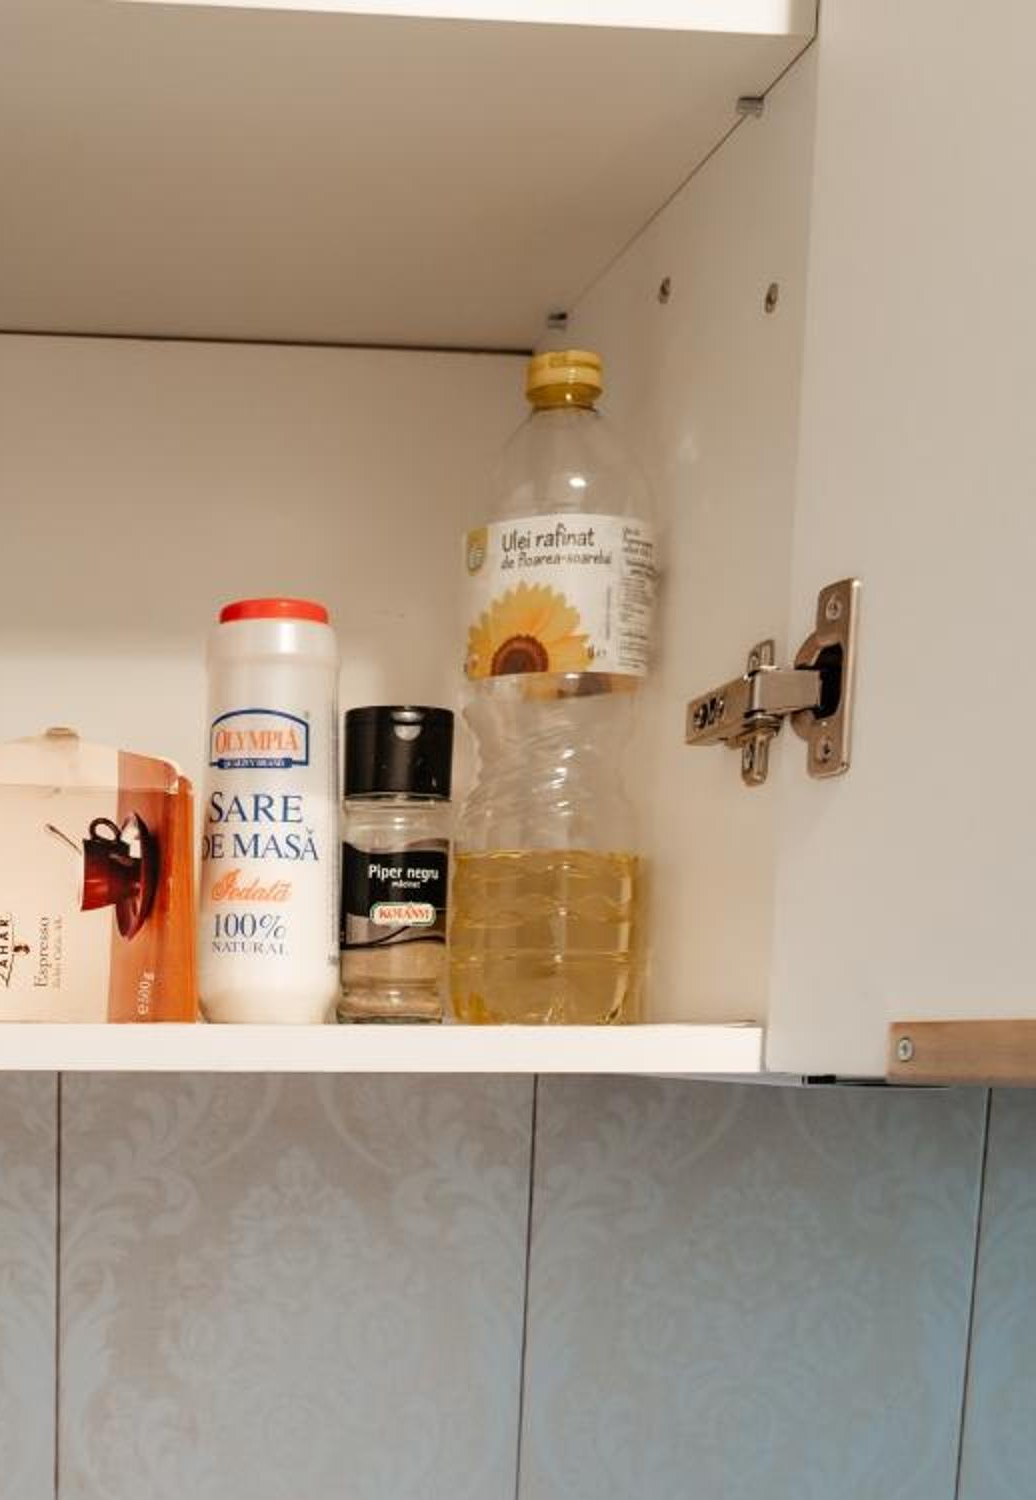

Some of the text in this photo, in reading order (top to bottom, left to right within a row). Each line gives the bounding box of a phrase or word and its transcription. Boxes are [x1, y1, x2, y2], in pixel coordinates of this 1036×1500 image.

[501, 522, 595, 553] Ulei rafinat
[501, 555, 515, 570] de
[215, 728, 300, 755] OLYMPIA
[209, 791, 303, 823] SARE
[232, 827, 319, 861] MASĂ
[368, 864, 439, 882] Piper negru
[213, 912, 285, 940] 100%
[33, 916, 50, 988] Espresso
[212, 940, 288, 956] NATURAL
